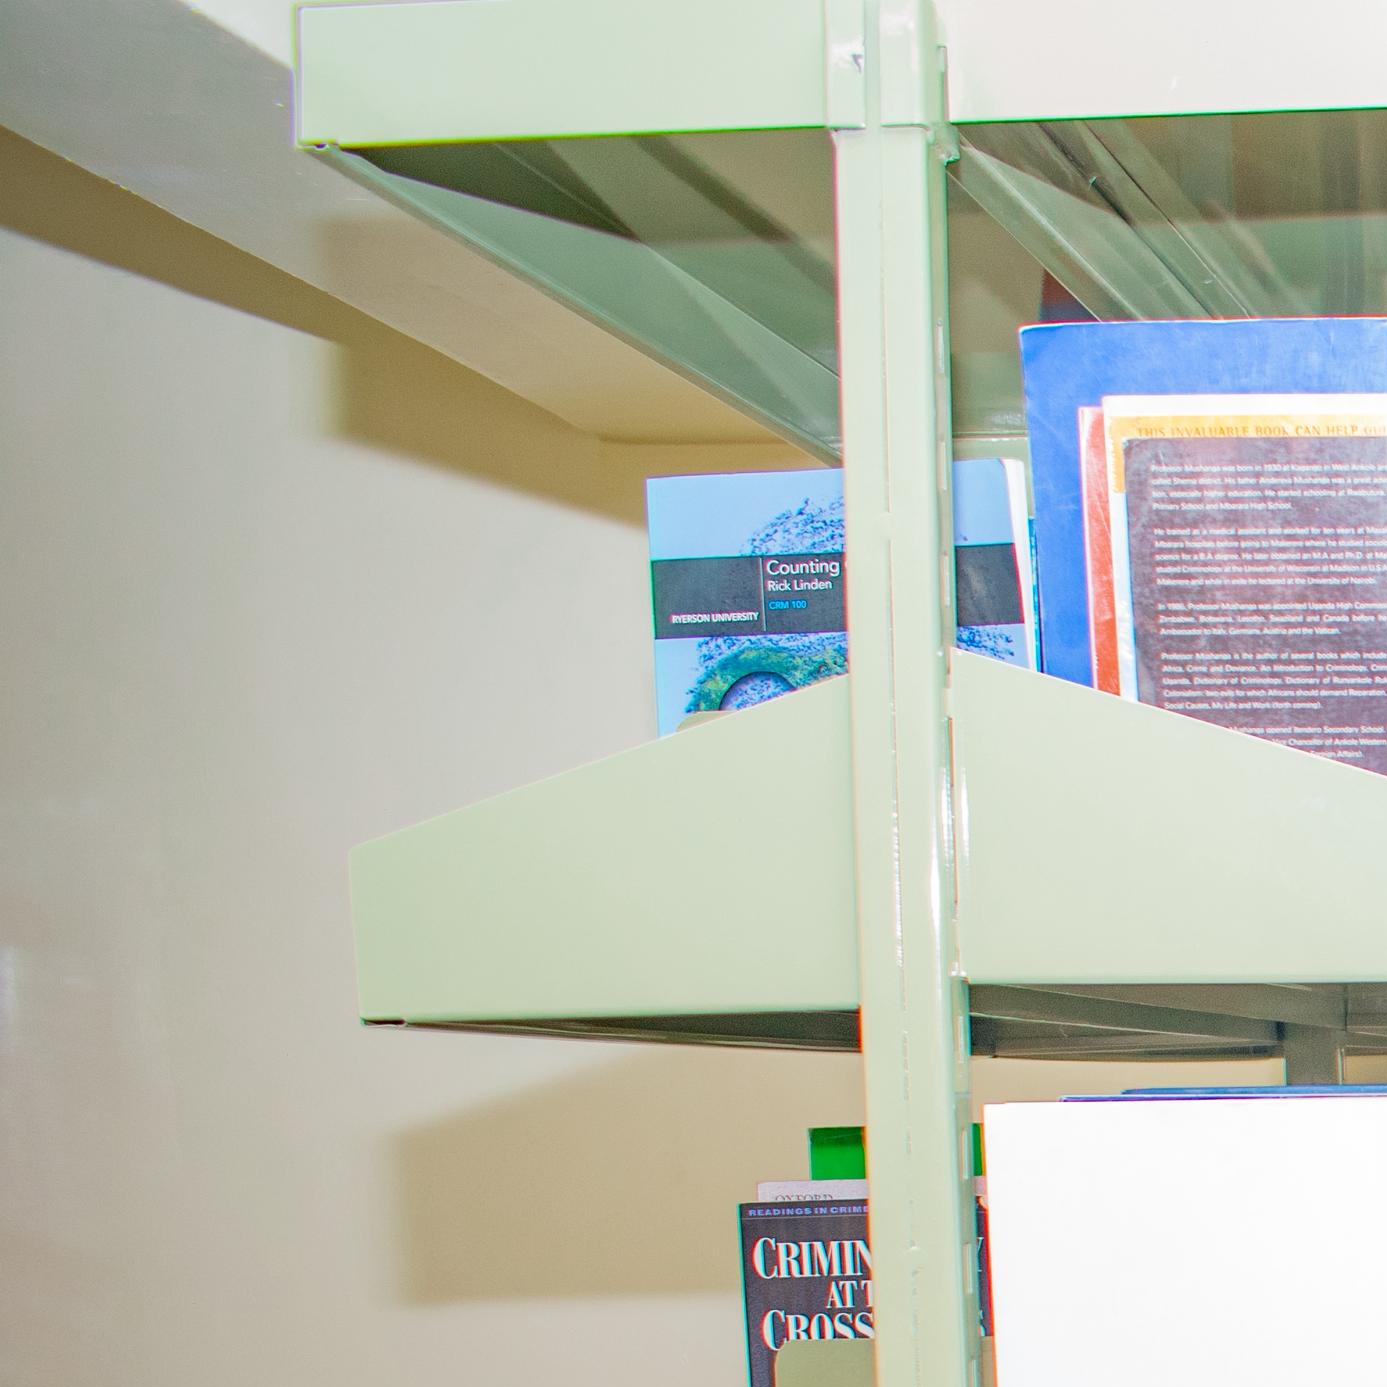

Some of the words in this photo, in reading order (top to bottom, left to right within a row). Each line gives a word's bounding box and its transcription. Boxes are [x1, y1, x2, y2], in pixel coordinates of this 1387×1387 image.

[766, 560, 840, 577] Counting
[767, 580, 792, 592] Rick
[794, 579, 833, 591] Linden
[768, 601, 790, 610] CRM
[791, 600, 808, 609] 100
[671, 613, 711, 624] RYERSON
[711, 612, 759, 623] UNIVERSITY
[749, 1207, 812, 1218] READINGS
[814, 1206, 828, 1215] IN
[826, 1280, 858, 1309] AT
